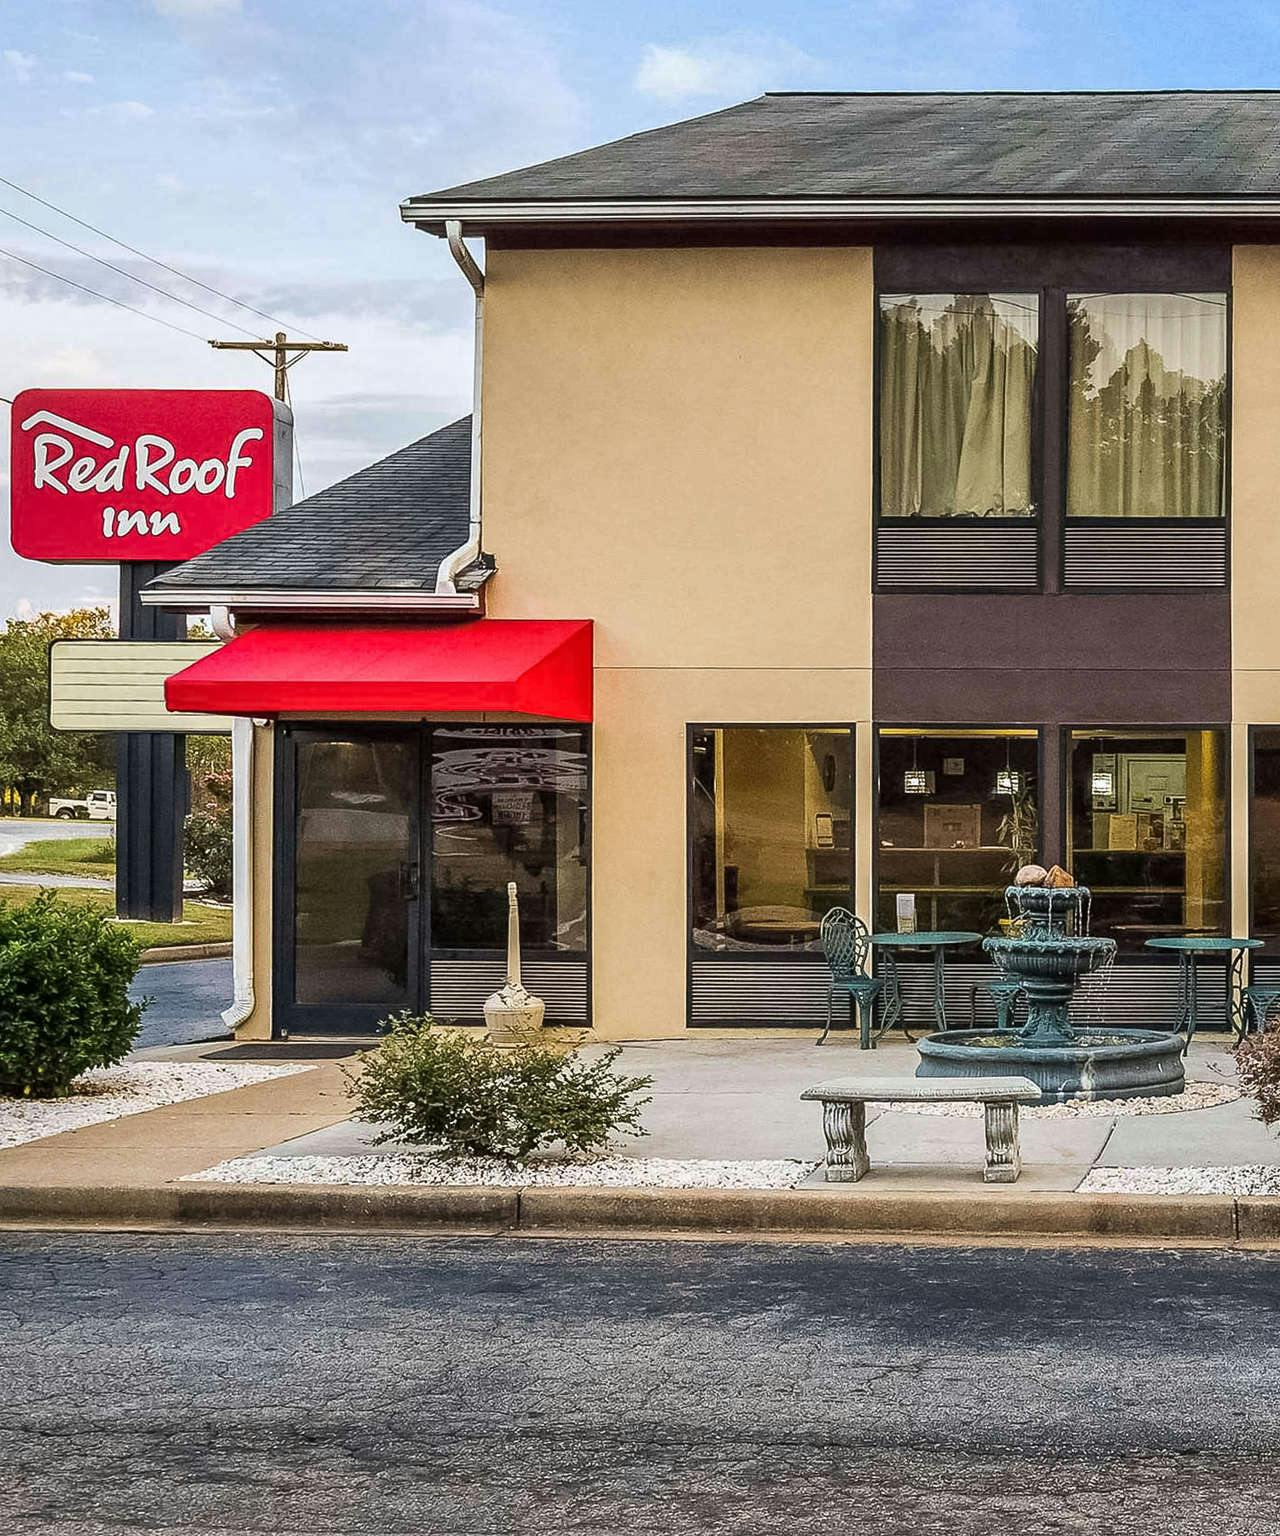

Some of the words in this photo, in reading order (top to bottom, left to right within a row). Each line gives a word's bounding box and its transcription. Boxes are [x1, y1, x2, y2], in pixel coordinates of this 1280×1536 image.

[33, 433, 130, 495] Red
[135, 428, 264, 498] Roof
[103, 507, 181, 537] Inn
